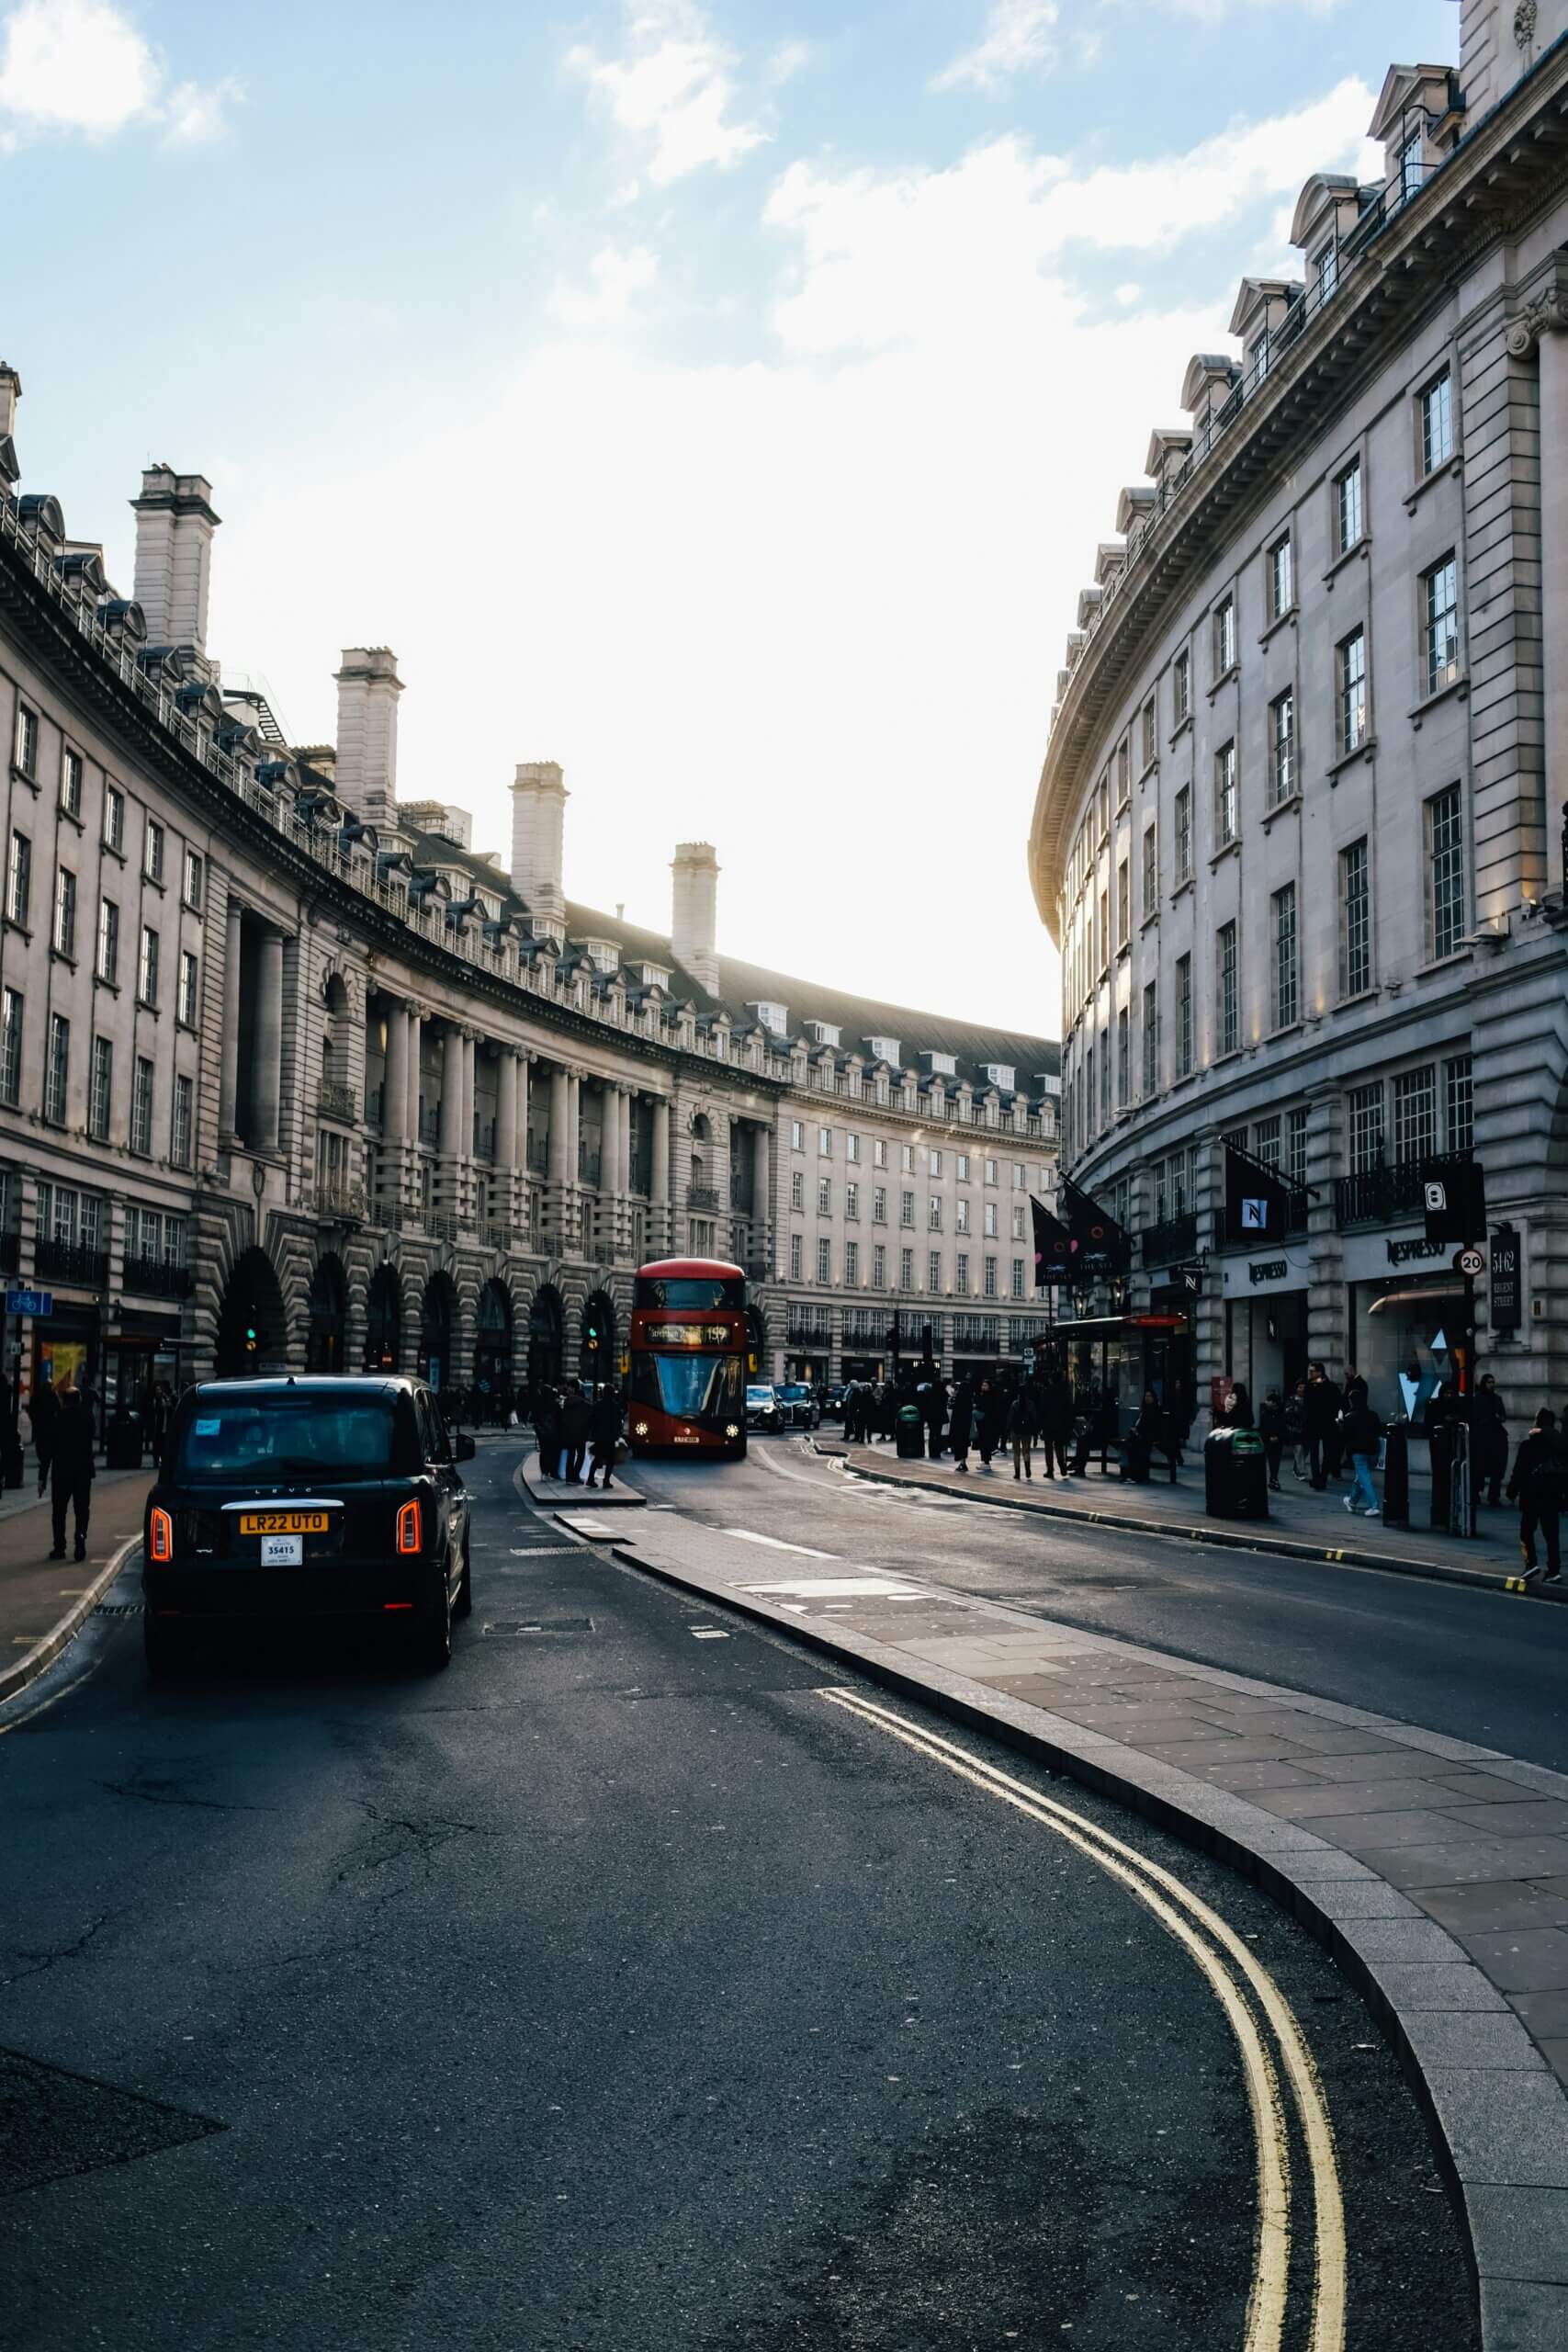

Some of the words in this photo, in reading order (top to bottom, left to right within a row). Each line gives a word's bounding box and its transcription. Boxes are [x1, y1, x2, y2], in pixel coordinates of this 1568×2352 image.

[1386, 1238, 1446, 1267] NESPRESSO
[1463, 1257, 1481, 1269] 20
[707, 1326, 728, 1340] 159
[247, 1515, 288, 1531] LR22
[292, 1514, 321, 1529] UTO
[268, 1545, 295, 1555] 35415
